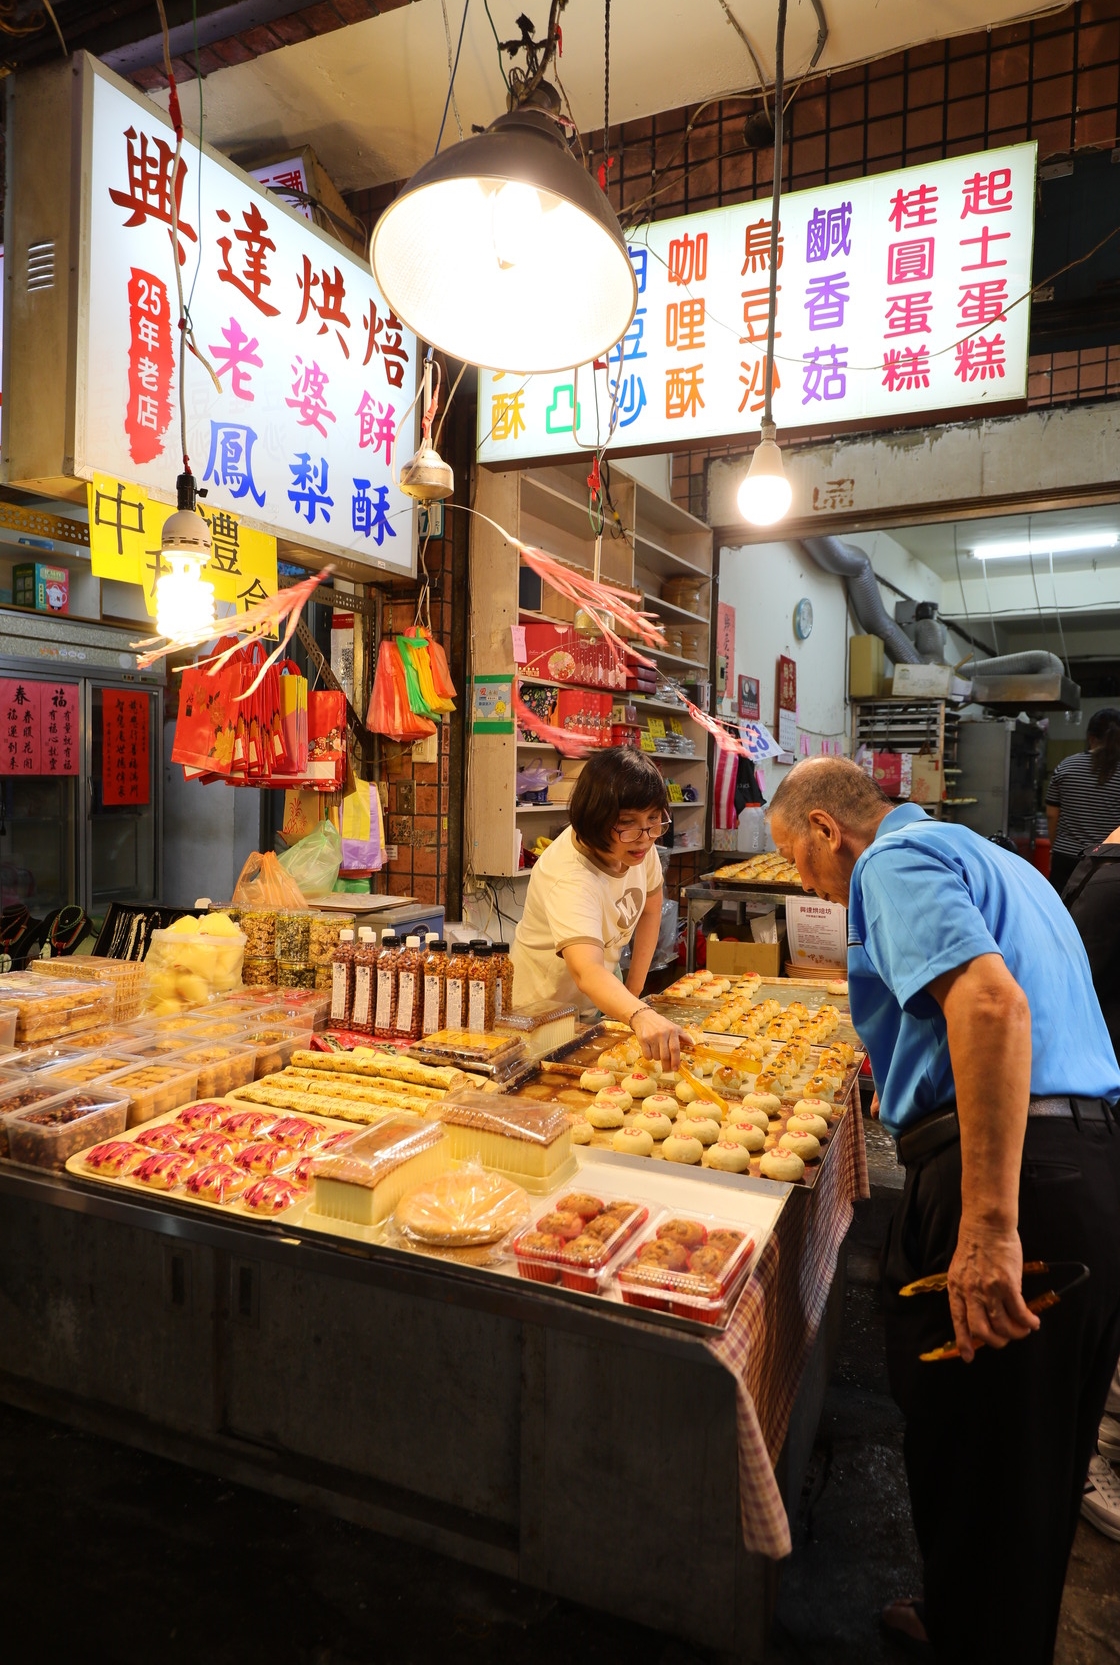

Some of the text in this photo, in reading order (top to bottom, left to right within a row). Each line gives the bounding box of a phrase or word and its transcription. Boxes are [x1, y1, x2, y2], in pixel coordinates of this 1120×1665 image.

[108, 125, 410, 389] 興達烘焙
[665, 232, 709, 419] 咖哩酥
[801, 201, 853, 405] 鹹香菇
[881, 184, 939, 392] 桂圓蛋糕
[954, 168, 1013, 382] 起士蛋糕
[137, 279, 162, 430] 25年老店
[208, 316, 396, 466] 老婆餅
[491, 371, 526, 441] 酥
[203, 420, 397, 546] 鳳梨酥
[13, 685, 31, 705] 春
[52, 688, 67, 708] 福
